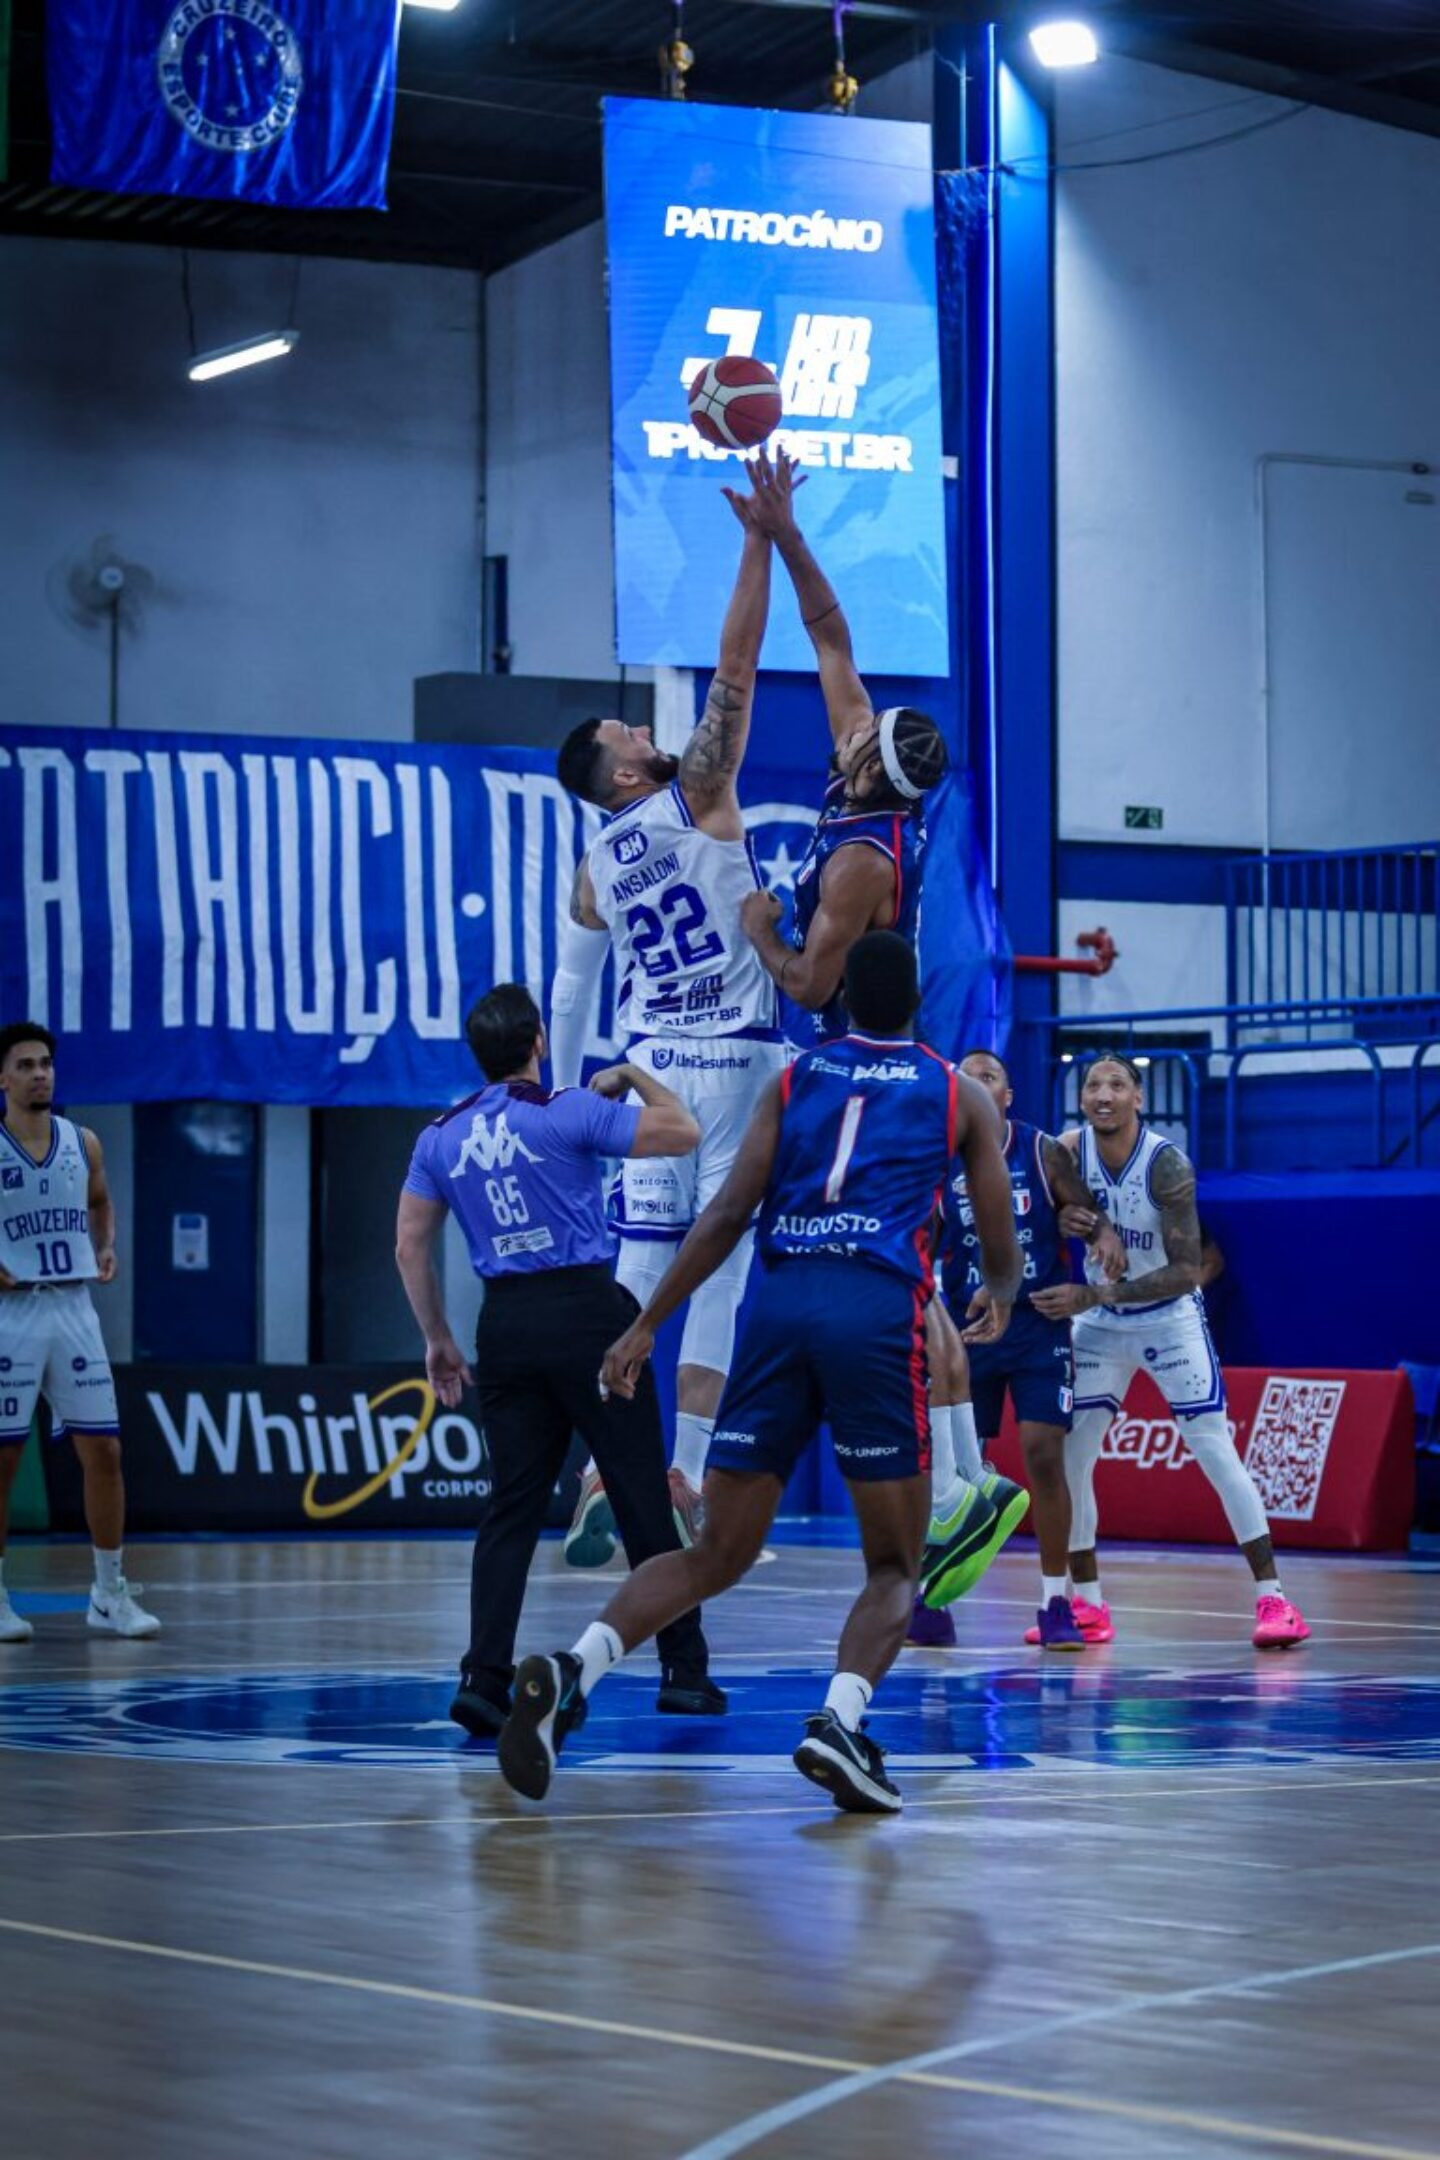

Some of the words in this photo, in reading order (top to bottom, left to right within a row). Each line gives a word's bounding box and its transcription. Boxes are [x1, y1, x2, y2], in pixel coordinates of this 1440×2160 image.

[173, 0, 288, 47] CRUZEIRO
[162, 63, 242, 146] ESPORTE
[252, 75, 298, 144] CLUBE
[664, 205, 883, 252] PATROCÍNIO
[612, 851, 680, 904] ANSALONI
[627, 882, 725, 978] 22
[826, 1096, 866, 1202] 1
[485, 1175, 530, 1227] 85
[771, 1212, 882, 1237] AUGUSTO
[36, 1240, 73, 1276] 10
[147, 1392, 489, 1499] Whirlpo
[423, 1479, 492, 1497] CORPO
